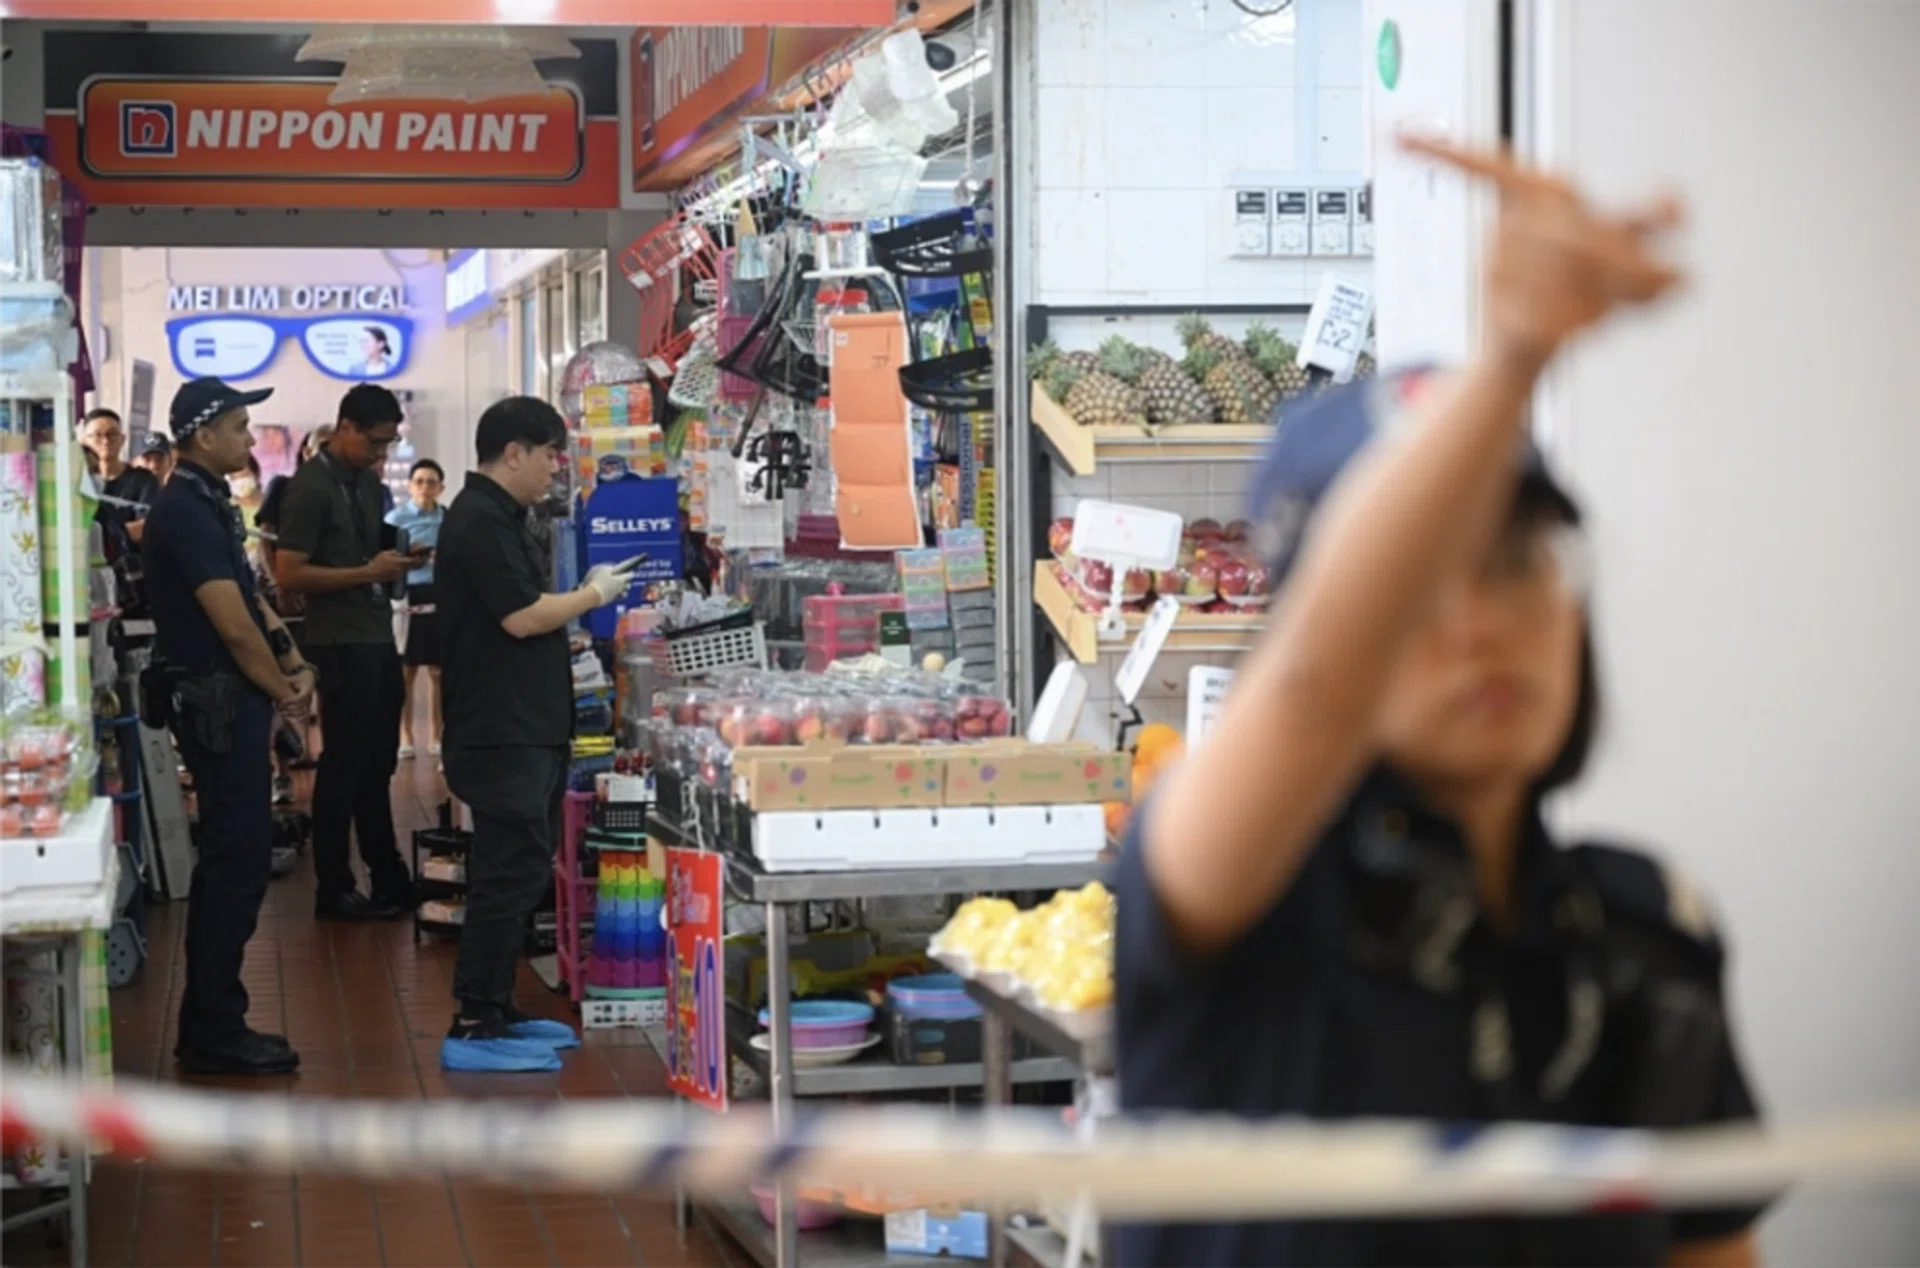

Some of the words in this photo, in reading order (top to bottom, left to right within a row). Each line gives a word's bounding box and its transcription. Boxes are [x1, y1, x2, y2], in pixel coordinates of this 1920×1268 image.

[186, 109, 384, 150] NIPPON
[395, 112, 548, 152] PAINT
[166, 286, 218, 311] MEI
[228, 286, 279, 311] LIM
[291, 285, 409, 311] OPTICAL
[591, 516, 672, 534] SELLEYS
